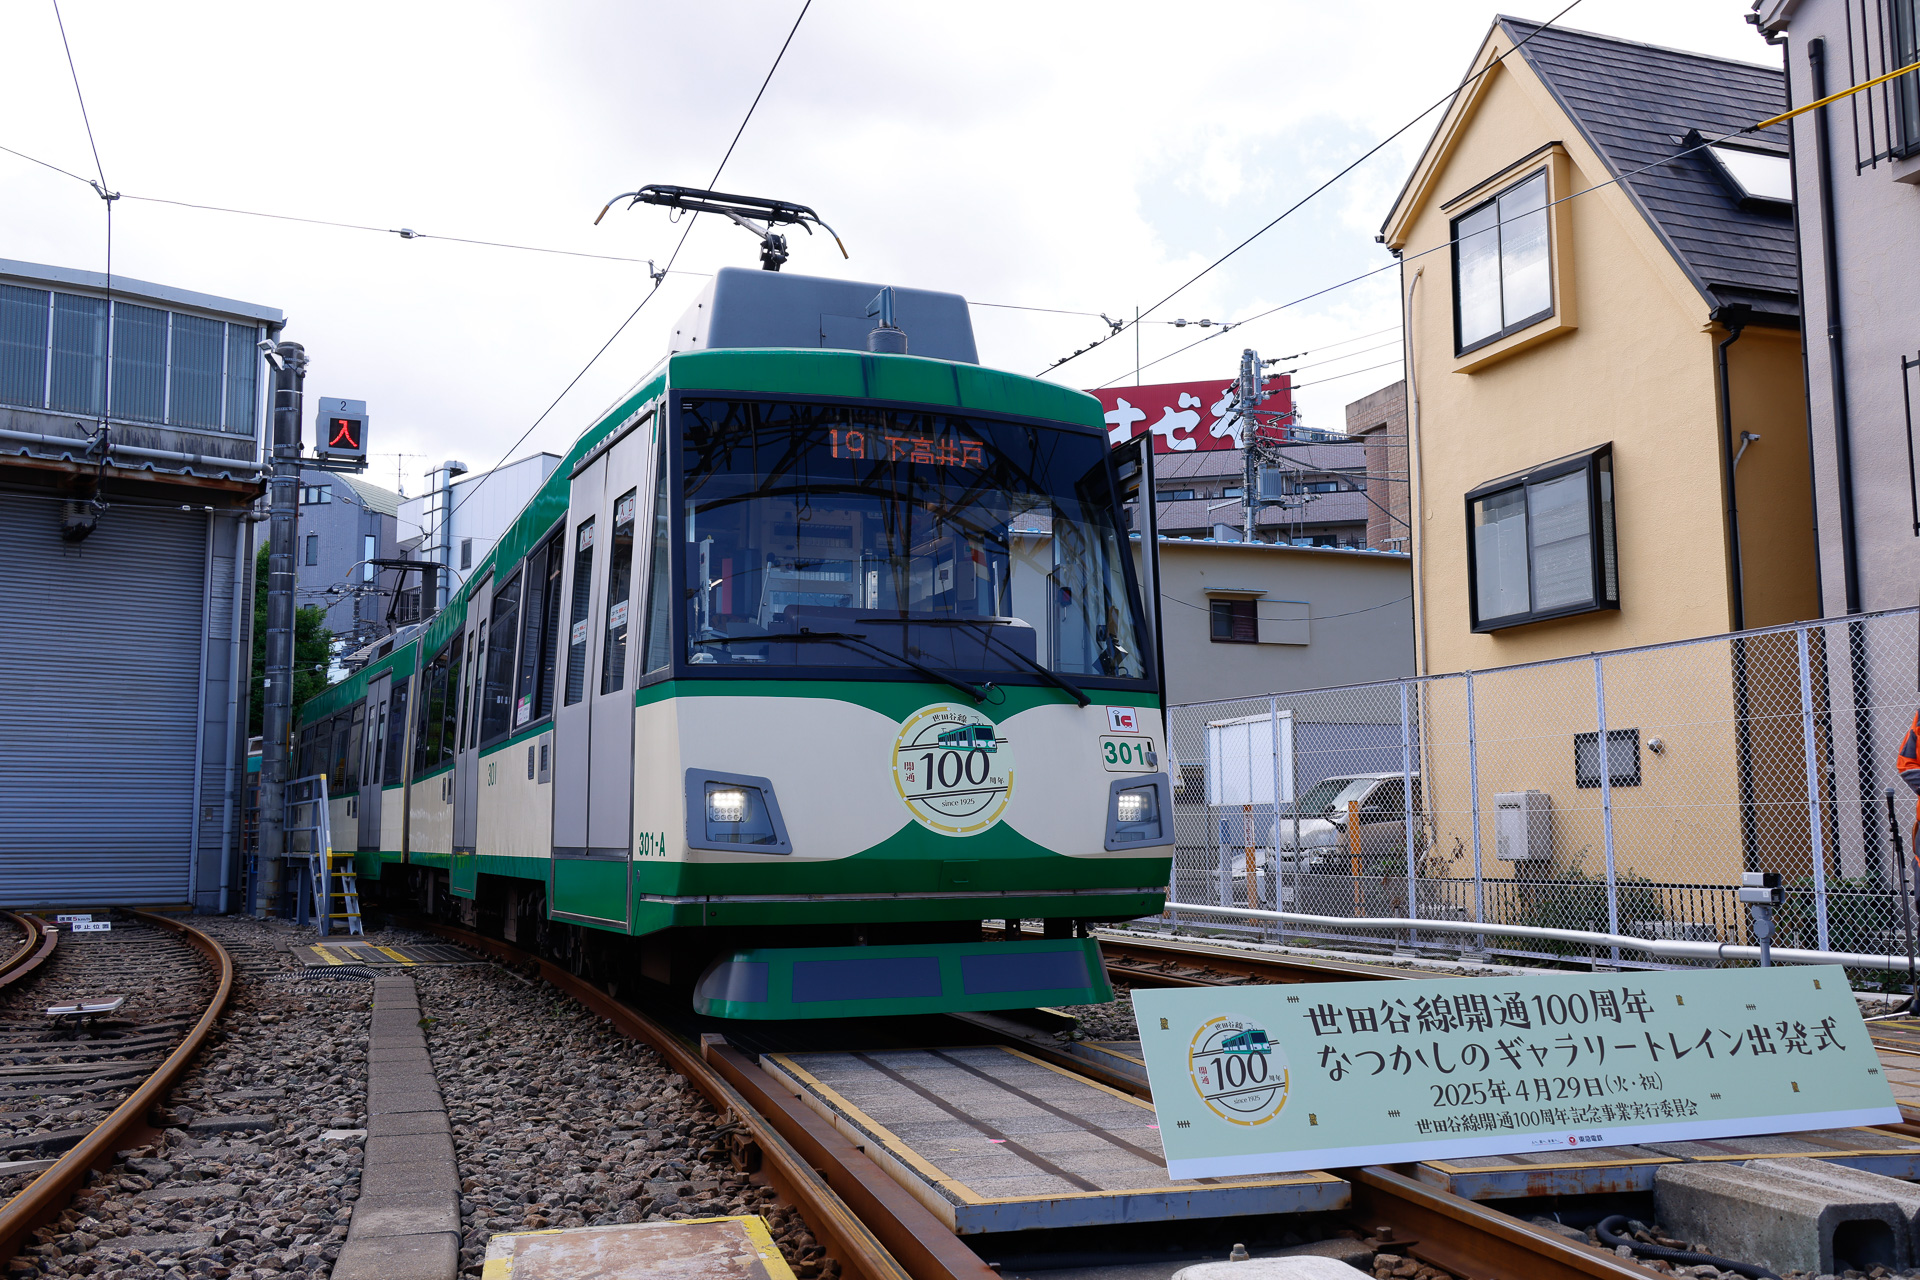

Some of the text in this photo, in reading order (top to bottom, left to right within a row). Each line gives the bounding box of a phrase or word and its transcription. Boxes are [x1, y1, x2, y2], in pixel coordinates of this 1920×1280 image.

[340, 401, 347, 411] 2
[830, 429, 983, 468] 19 下高井戸
[933, 713, 968, 723] 世田谷線
[920, 749, 990, 790] 100
[1104, 742, 1144, 765] 301
[488, 761, 497, 786] 301
[639, 832, 666, 857] 301-A
[1303, 987, 1655, 1036] 世田谷線開通100周年
[1317, 1015, 1847, 1082] なつかしのギャラリートレイン出発式
[1210, 1051, 1268, 1090] 100
[1415, 1098, 1698, 1135] 世田谷線開通100周年記念事業実行委員会
